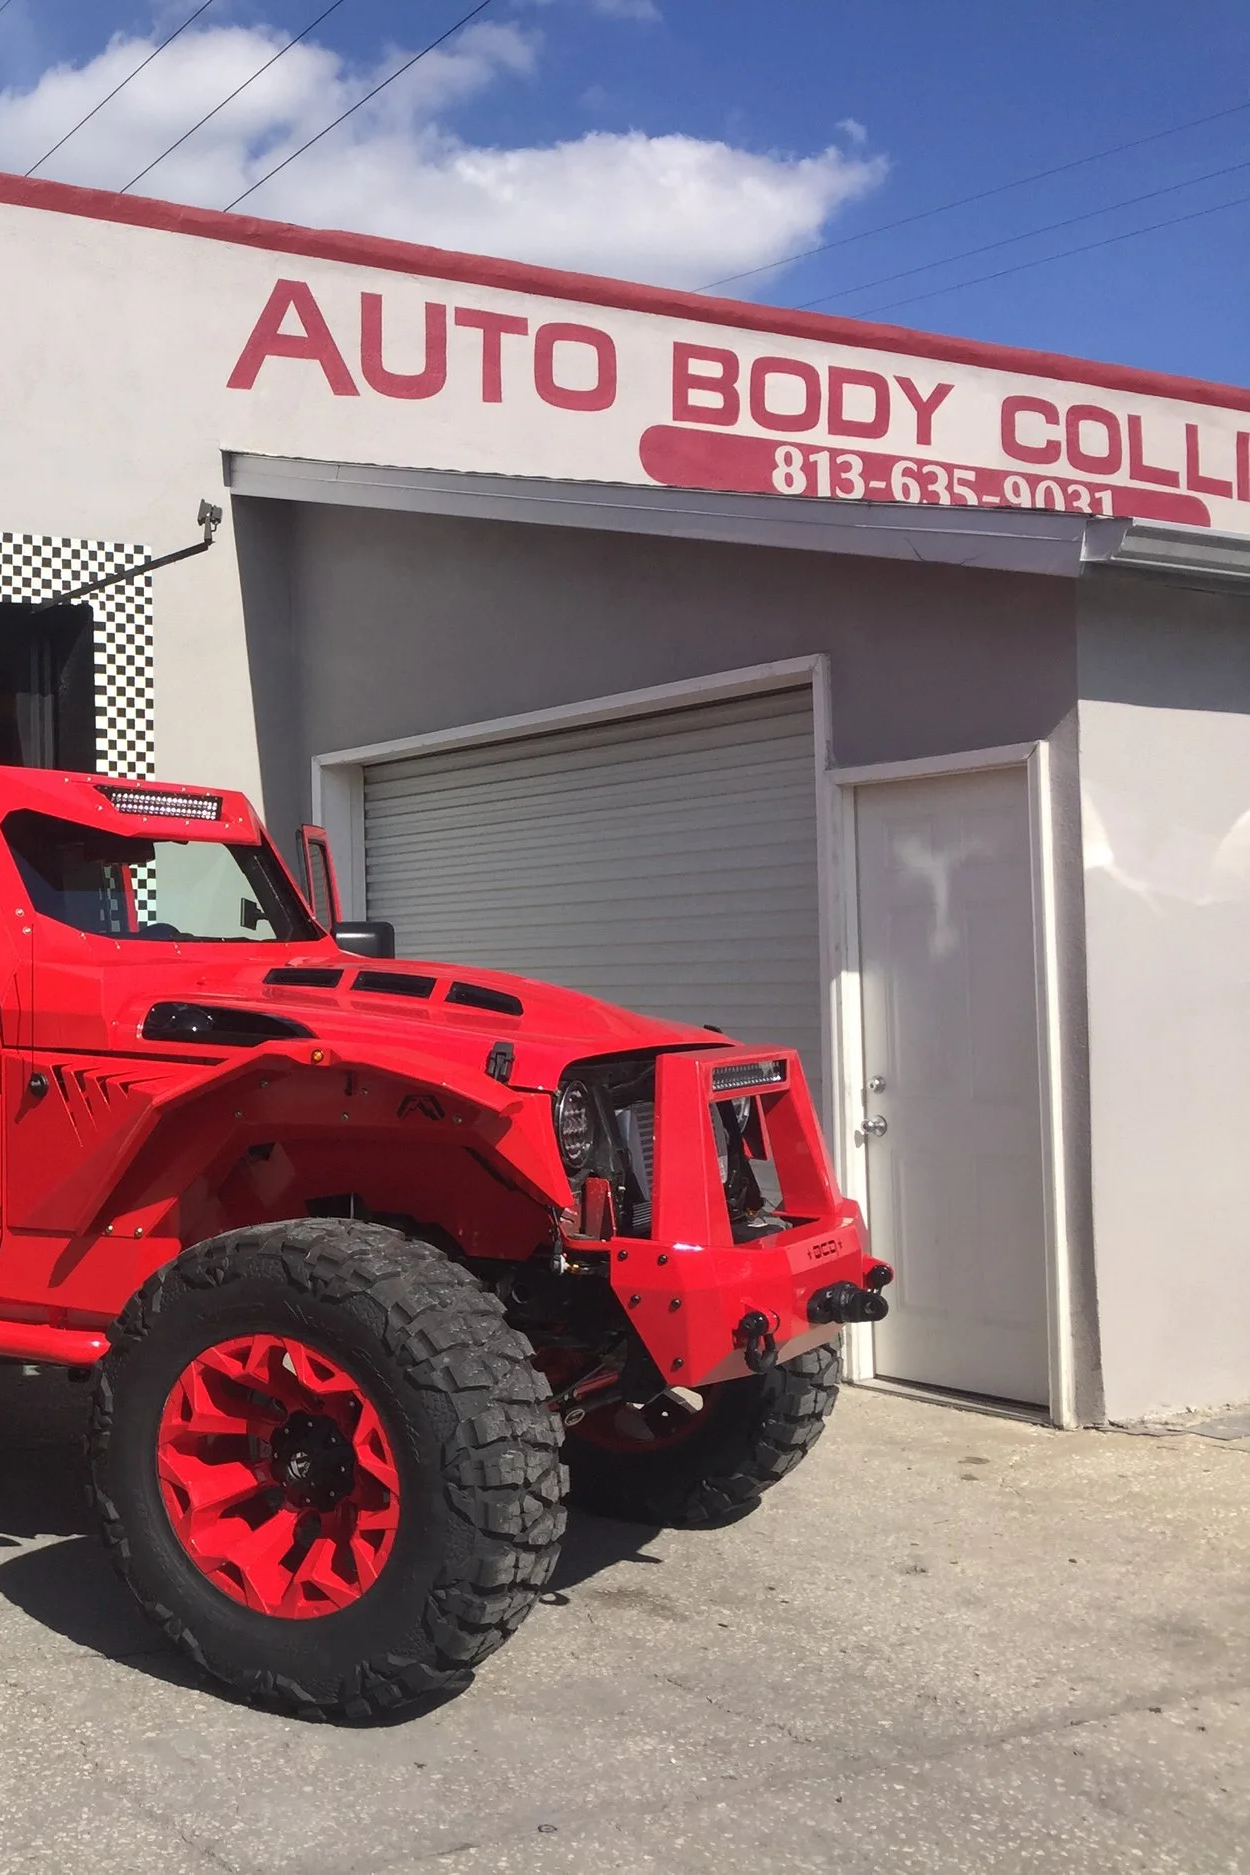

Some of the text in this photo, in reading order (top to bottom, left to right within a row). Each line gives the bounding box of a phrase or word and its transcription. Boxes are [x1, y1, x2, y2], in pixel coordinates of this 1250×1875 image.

[226, 278, 1250, 502] AUTO BODY COLLI
[772, 445, 1114, 516] 813-635-9031
